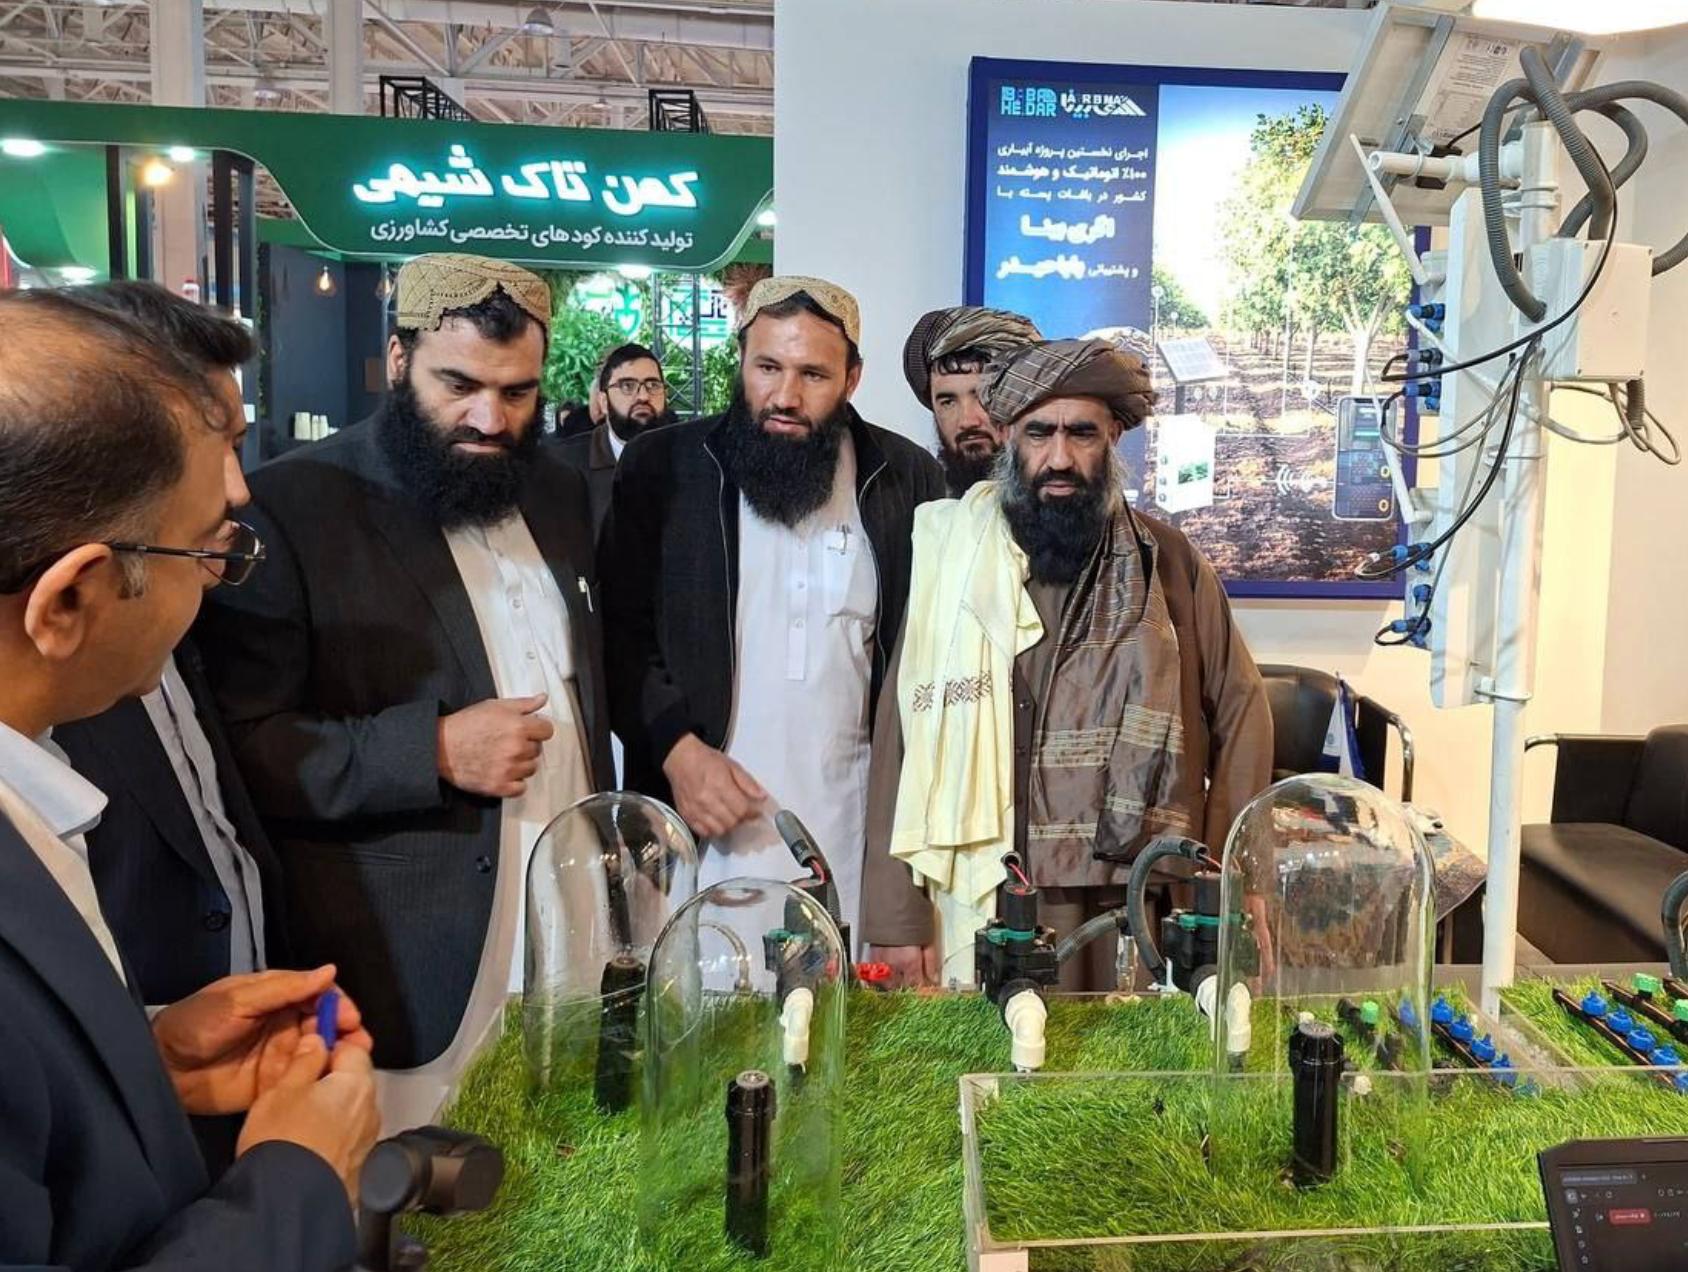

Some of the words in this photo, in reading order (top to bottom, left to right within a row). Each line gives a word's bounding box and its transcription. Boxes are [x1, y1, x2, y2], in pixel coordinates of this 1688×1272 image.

[997, 141, 1033, 157] آبیاری
[1035, 144, 1065, 160] پروژه
[1067, 146, 1113, 160] نخستین
[1114, 147, 1149, 161] اجرای
[353, 144, 494, 208] شیمی
[501, 160, 592, 201] تاک
[997, 163, 1050, 181] هوشمند
[1051, 168, 1060, 181] و
[1062, 164, 1119, 182] اتوماتیک
[1097, 191, 1108, 203] در
[1113, 190, 1147, 204] کشور
[370, 218, 449, 241] کشاورزی
[450, 224, 529, 244] تخصصی
[605, 229, 649, 247] کننده
[650, 231, 694, 253] تولید
